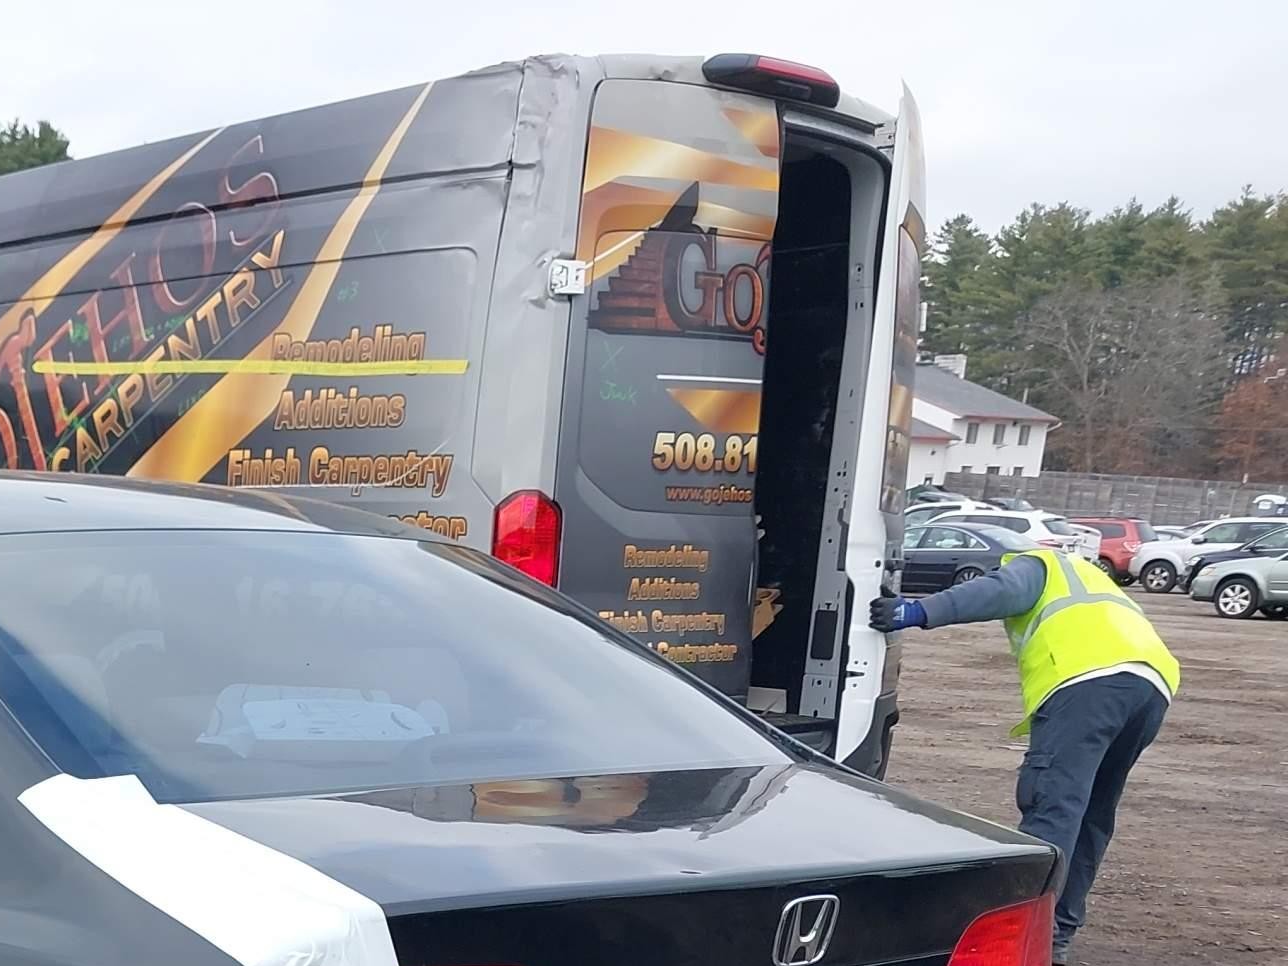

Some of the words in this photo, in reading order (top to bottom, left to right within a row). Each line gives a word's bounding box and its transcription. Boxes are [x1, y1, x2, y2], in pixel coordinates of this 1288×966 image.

[274, 387, 406, 431] Additions
[227, 447, 301, 488] Finish
[308, 446, 454, 497] Carpentry
[623, 543, 710, 573] Remodeling
[627, 576, 700, 601] Additions
[650, 608, 726, 637] Carpentry
